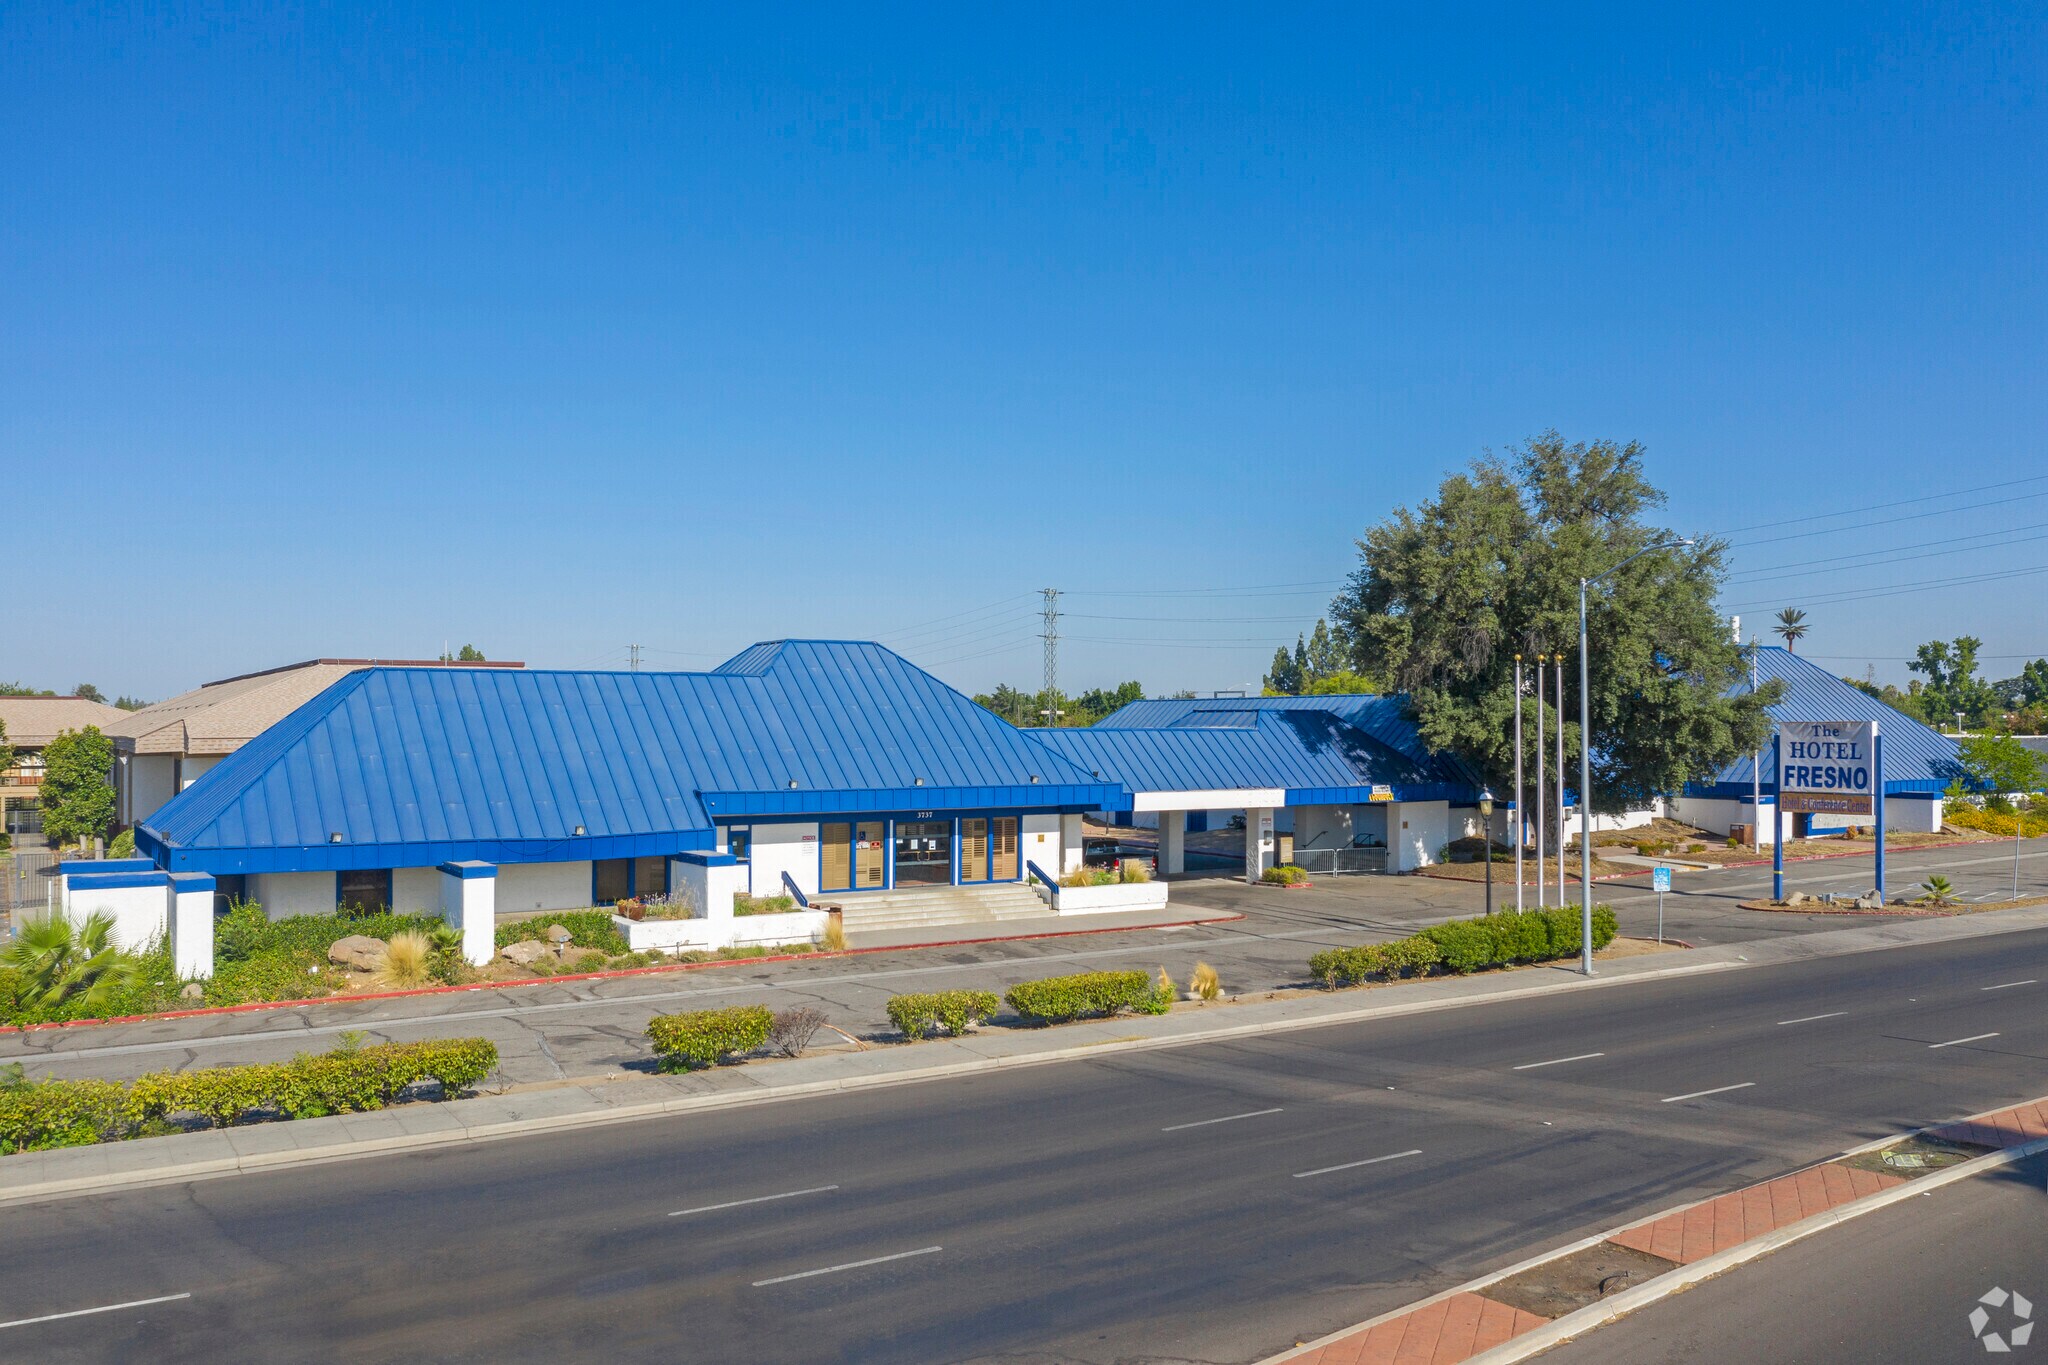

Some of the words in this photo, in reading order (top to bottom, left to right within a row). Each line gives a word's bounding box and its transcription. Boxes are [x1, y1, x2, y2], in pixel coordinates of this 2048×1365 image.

[1812, 725, 1840, 737] The
[1790, 741, 1863, 760] HOTEL
[1784, 765, 1868, 790] FRESNO
[1781, 796, 1800, 809] Hotel
[1801, 798, 1807, 810] &
[1807, 797, 1845, 812] Conference
[1847, 798, 1869, 813] Center
[917, 811, 933, 819] 3737
